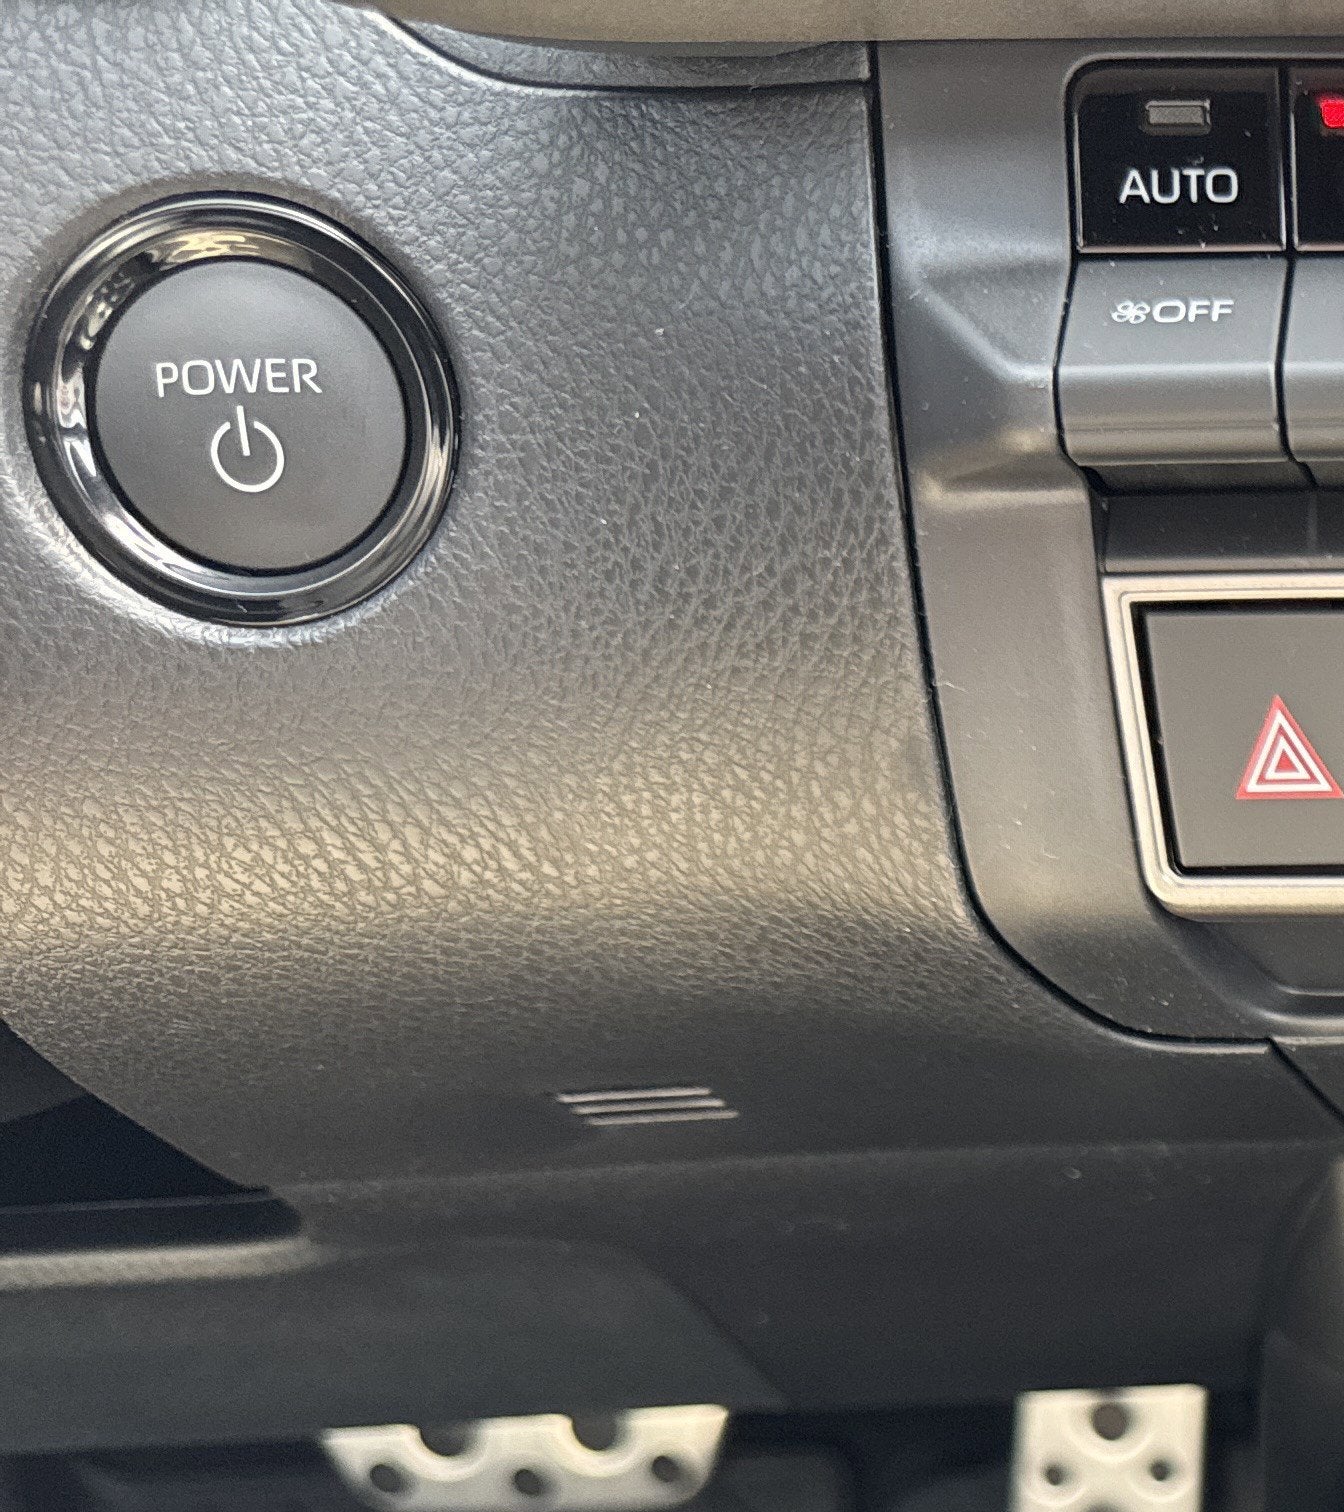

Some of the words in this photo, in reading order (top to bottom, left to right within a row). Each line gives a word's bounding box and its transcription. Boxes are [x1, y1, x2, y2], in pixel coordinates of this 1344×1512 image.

[1118, 168, 1239, 204] AUTO
[1151, 298, 1234, 324] OFF
[155, 358, 323, 398] POWER
